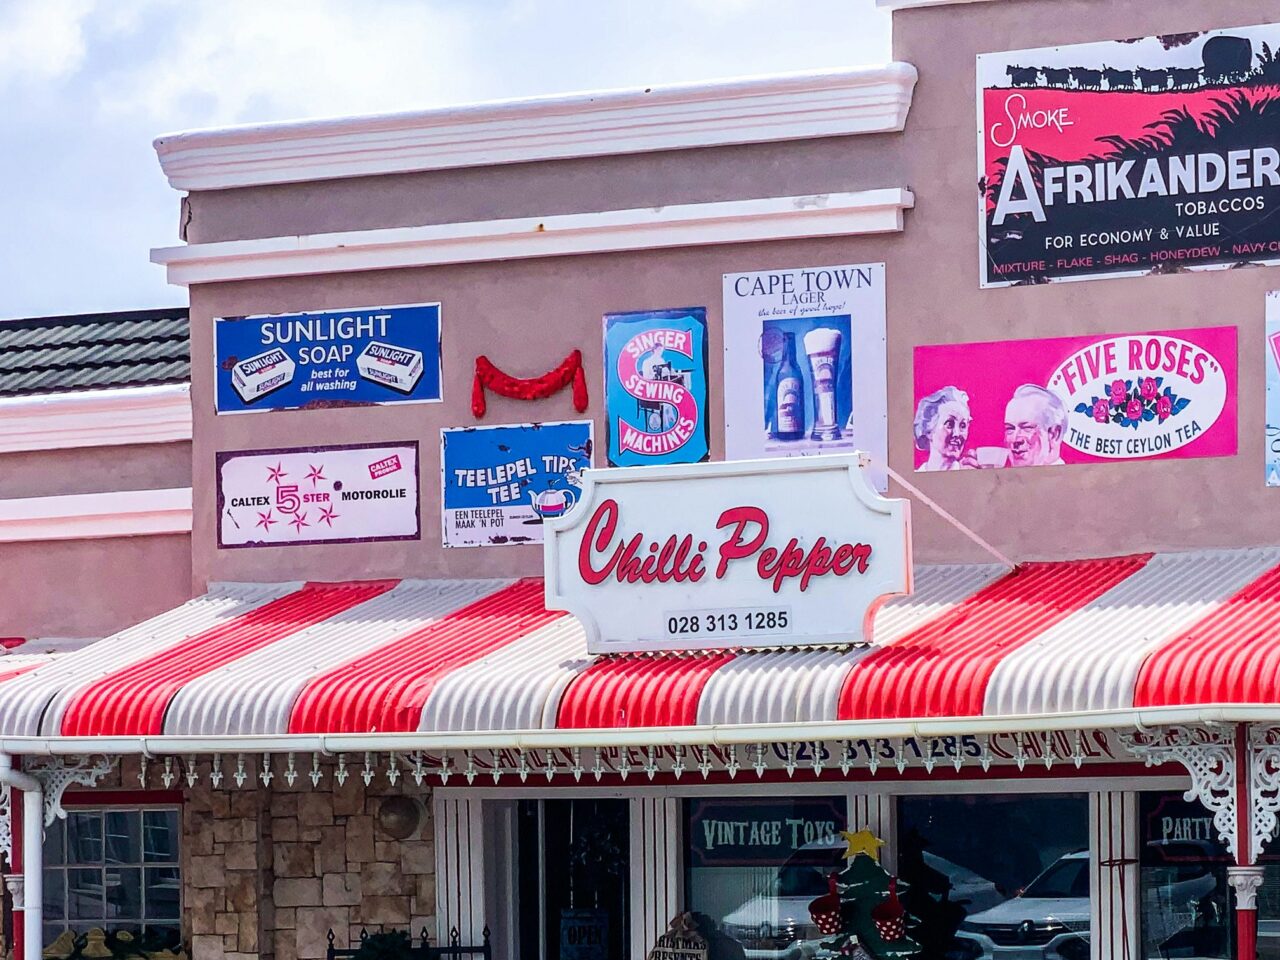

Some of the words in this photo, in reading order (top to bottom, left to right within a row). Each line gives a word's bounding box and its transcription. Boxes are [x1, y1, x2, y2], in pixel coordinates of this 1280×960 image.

[1175, 196, 1265, 217] TOBACCOS
[1045, 236, 1073, 250] FOR
[1080, 228, 1153, 247] ECONOMY
[1160, 227, 1168, 240] &
[1176, 223, 1220, 238] VALUE
[993, 260, 1046, 274] MIXTURE
[1057, 256, 1093, 269] FLAKE
[1104, 252, 1138, 265] SHAG
[1151, 246, 1221, 261] HONEYDEW
[1233, 241, 1267, 254] NAVY
[734, 274, 795, 297] CAPE
[805, 267, 873, 292] TOWN
[782, 291, 826, 305] LAGER
[260, 314, 392, 345] SUNLIGHT
[298, 345, 354, 366] SOAP
[369, 345, 413, 364] SUNLIGHT
[626, 330, 687, 358] SINGER
[242, 351, 283, 374] SUNLIGHT
[310, 368, 331, 380] best
[334, 367, 349, 378] for
[301, 381, 314, 392] all
[316, 378, 357, 391] washing
[626, 374, 683, 404] SEWING
[622, 418, 695, 453] MACHINES
[1069, 427, 1090, 450] THE
[1095, 437, 1122, 455] BEST
[1126, 434, 1172, 454] CEYLON
[1174, 419, 1202, 445] TEA
[455, 458, 537, 487] TEELEPEL
[542, 455, 576, 473] TIPS
[231, 495, 270, 508] CALTEX
[276, 485, 301, 514] 5
[303, 492, 330, 504] STER
[341, 487, 407, 501] MOTOROLIE
[487, 482, 521, 504] TEE
[455, 510, 468, 520] EEN
[470, 509, 504, 519] TEELEPEL
[455, 519, 475, 529] MAAK
[490, 518, 504, 528] POT
[578, 499, 707, 586] Chilli
[716, 505, 872, 593] Pepper
[668, 615, 700, 635] 028
[706, 613, 738, 633] 313
[747, 611, 788, 631] 1285
[702, 819, 782, 850] VINTAGE
[785, 817, 835, 849] TOYS
[1162, 816, 1213, 845] PARTY
